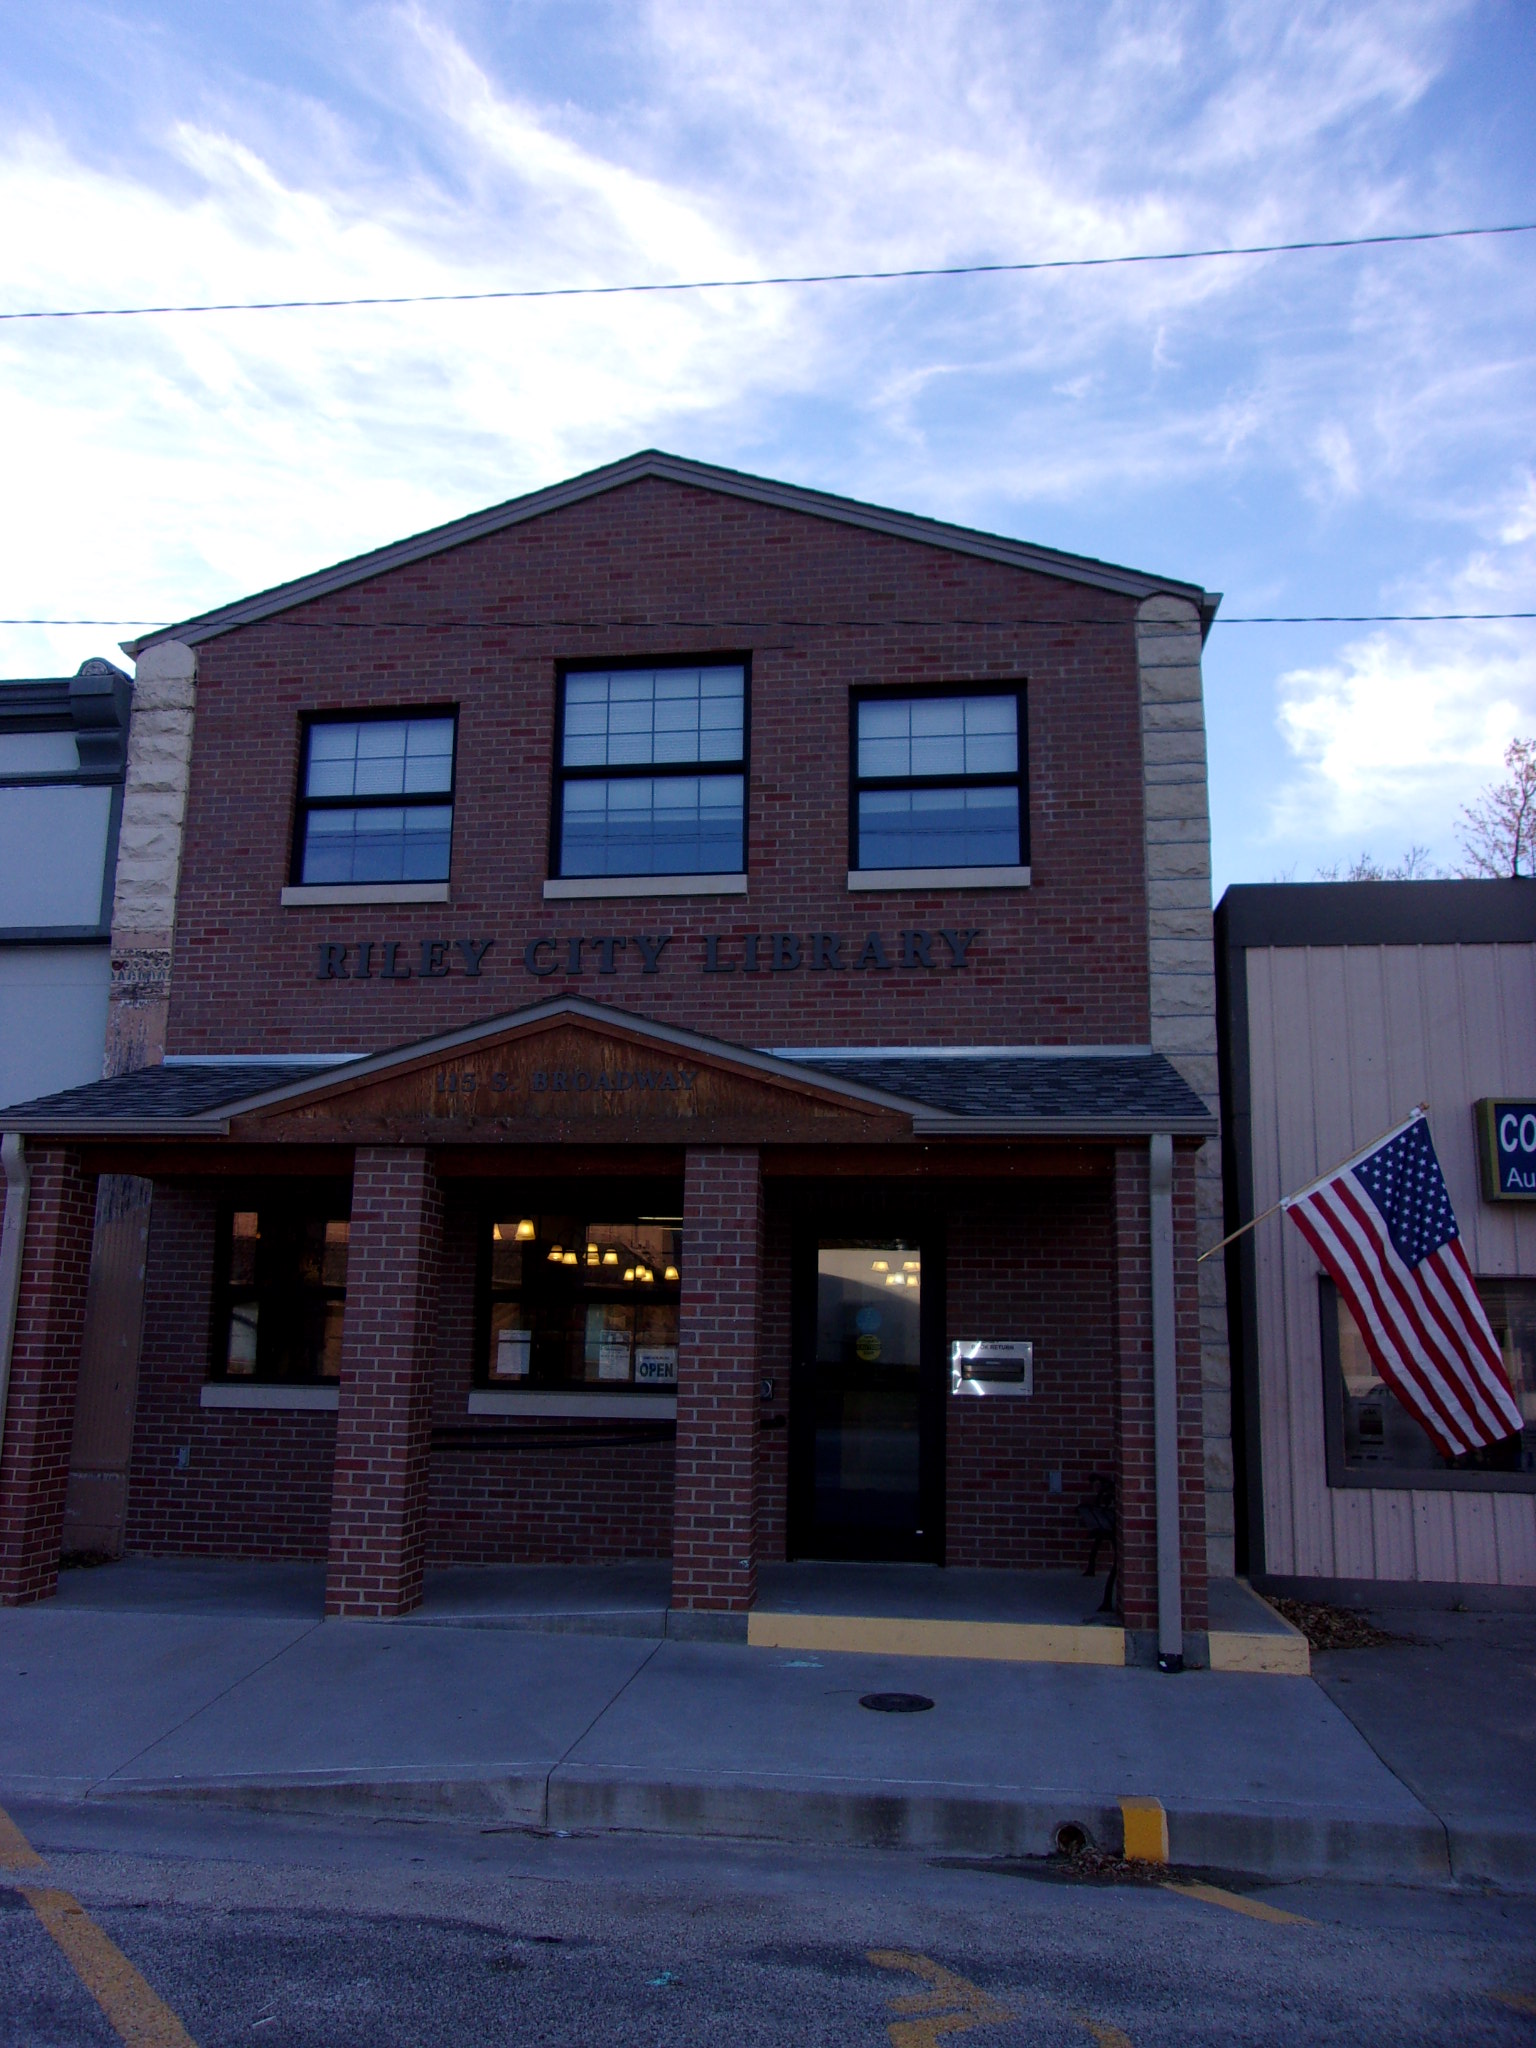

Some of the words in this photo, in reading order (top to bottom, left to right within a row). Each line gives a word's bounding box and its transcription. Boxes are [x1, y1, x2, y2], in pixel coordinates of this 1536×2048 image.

[317, 940, 494, 979] RILEY
[524, 936, 672, 973] CITY
[703, 928, 980, 972] LIBRARY
[436, 1072, 477, 1093] 115
[491, 1072, 517, 1093] S.
[533, 1071, 698, 1092] BROADWAY
[640, 1362, 674, 1377] OPEN
